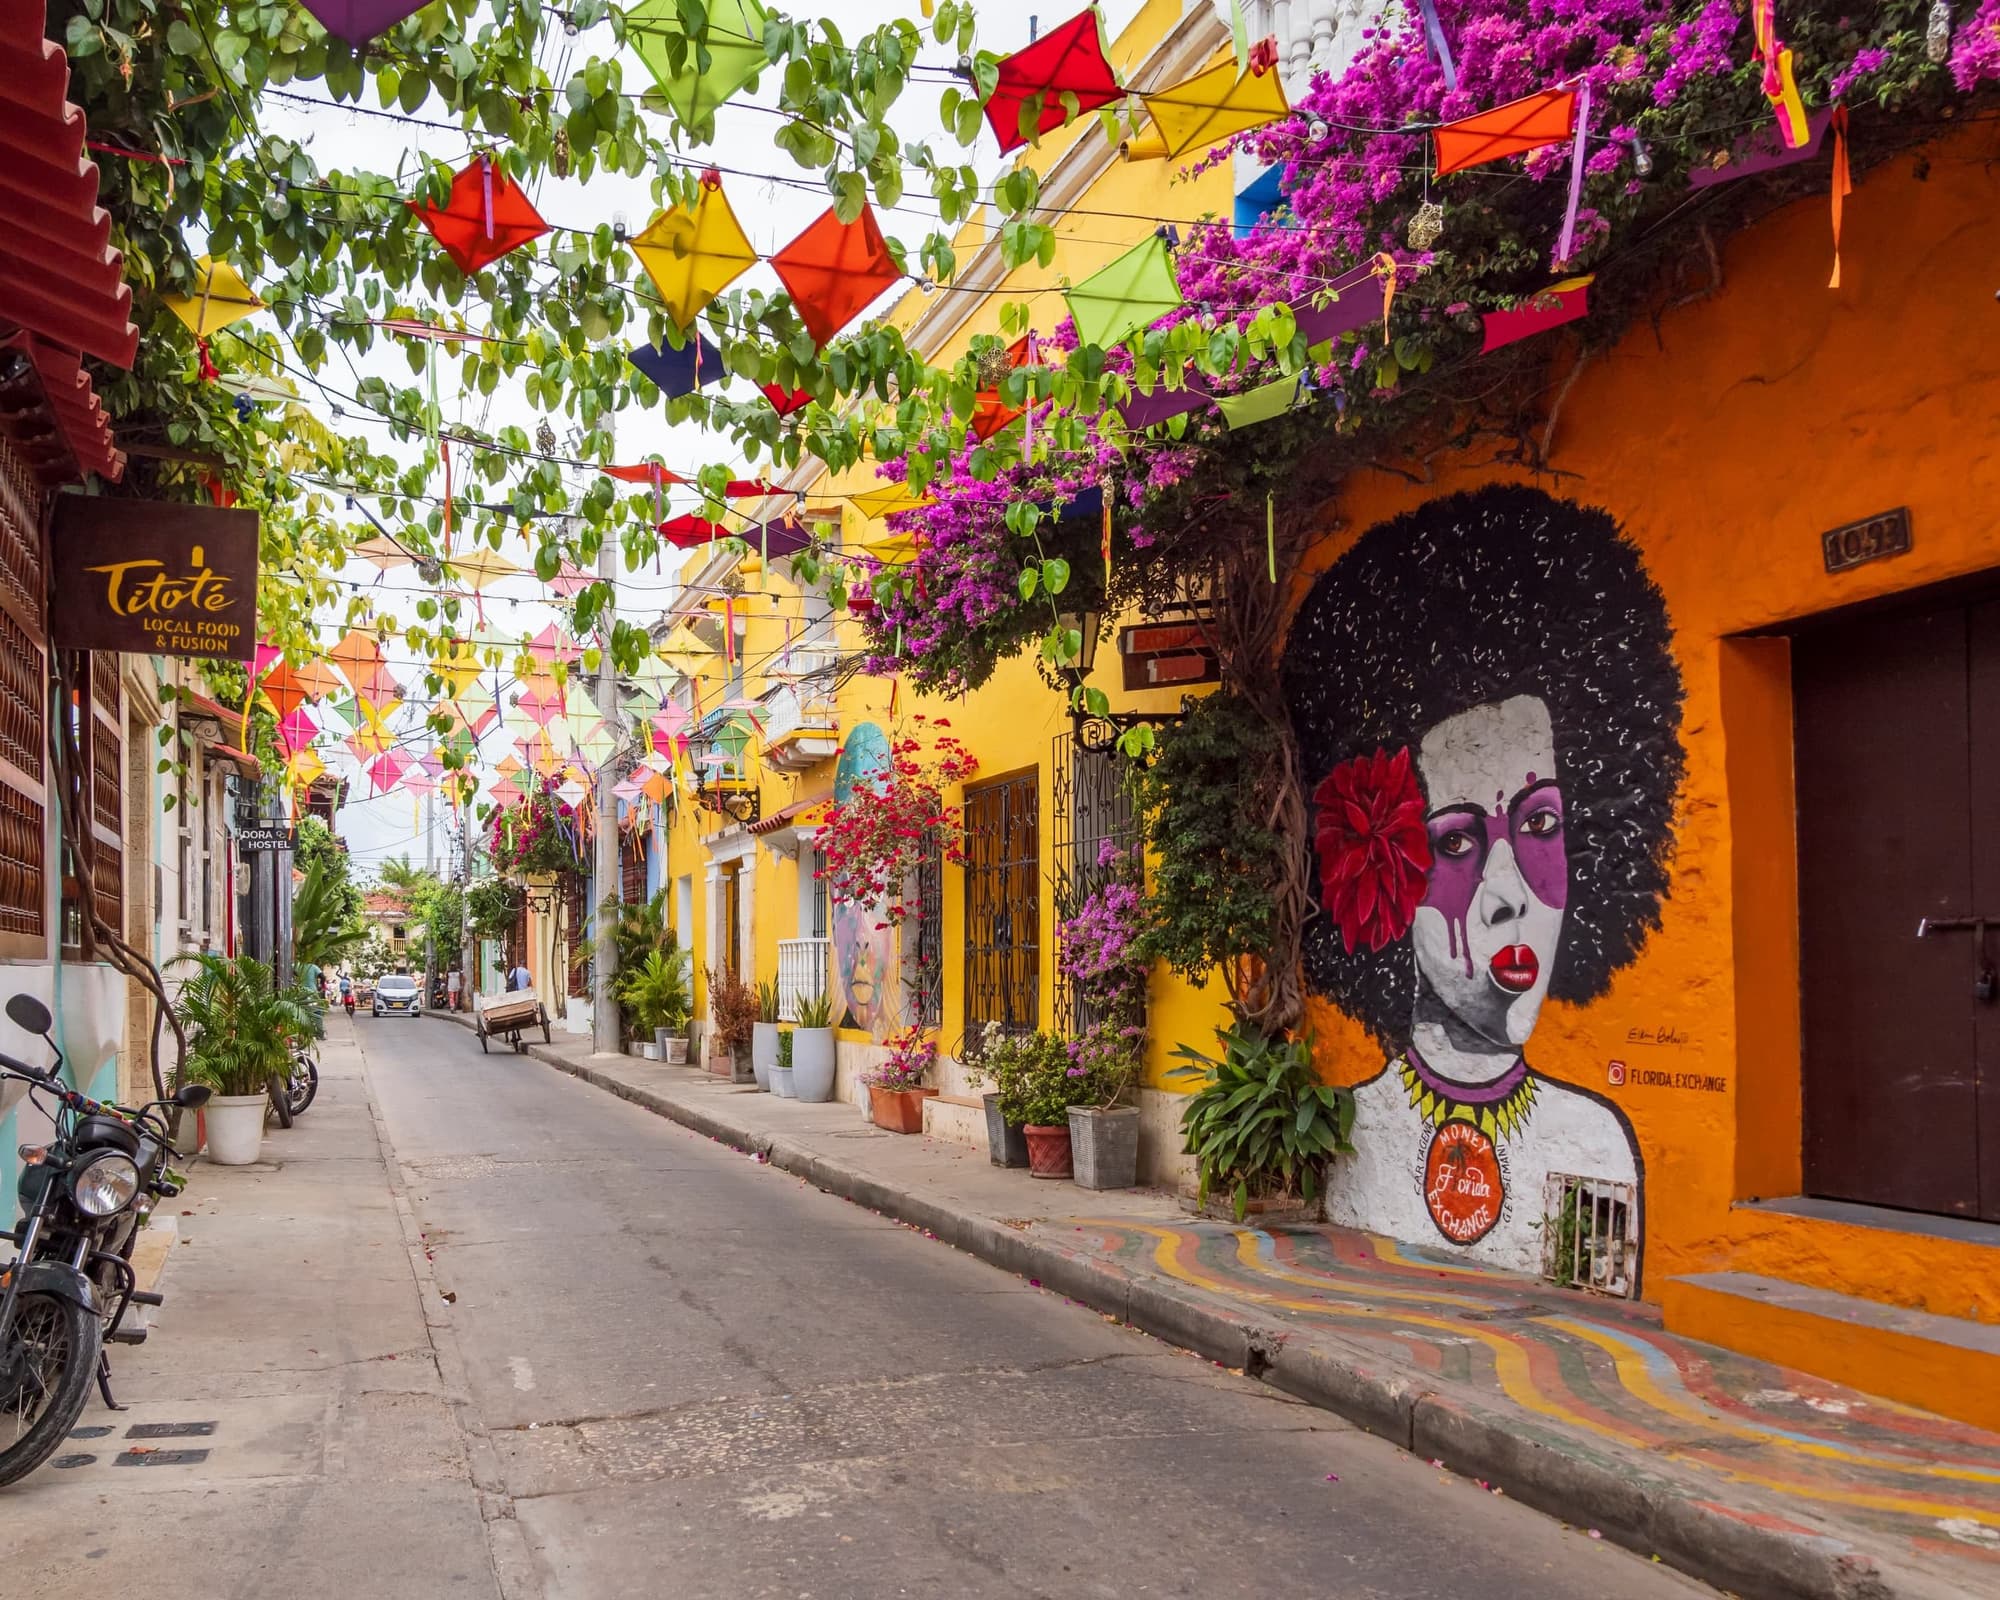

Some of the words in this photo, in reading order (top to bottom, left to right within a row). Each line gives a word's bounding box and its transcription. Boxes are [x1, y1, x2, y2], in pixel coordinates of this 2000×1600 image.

[144, 618, 192, 634] LOCAL
[197, 622, 240, 637] FOOD
[156, 635, 167, 647] &
[172, 636, 228, 651] FUSION
[248, 840, 291, 849] HOSTEL
[1631, 1069, 1727, 1092] FLORIDA.EXCHANGE
[1439, 1124, 1490, 1154] MONEY
[1413, 1121, 1434, 1196] CARTAGENA
[1497, 1144, 1513, 1224] GETSEMANI
[1428, 1190, 1492, 1237] EXCHANGE
